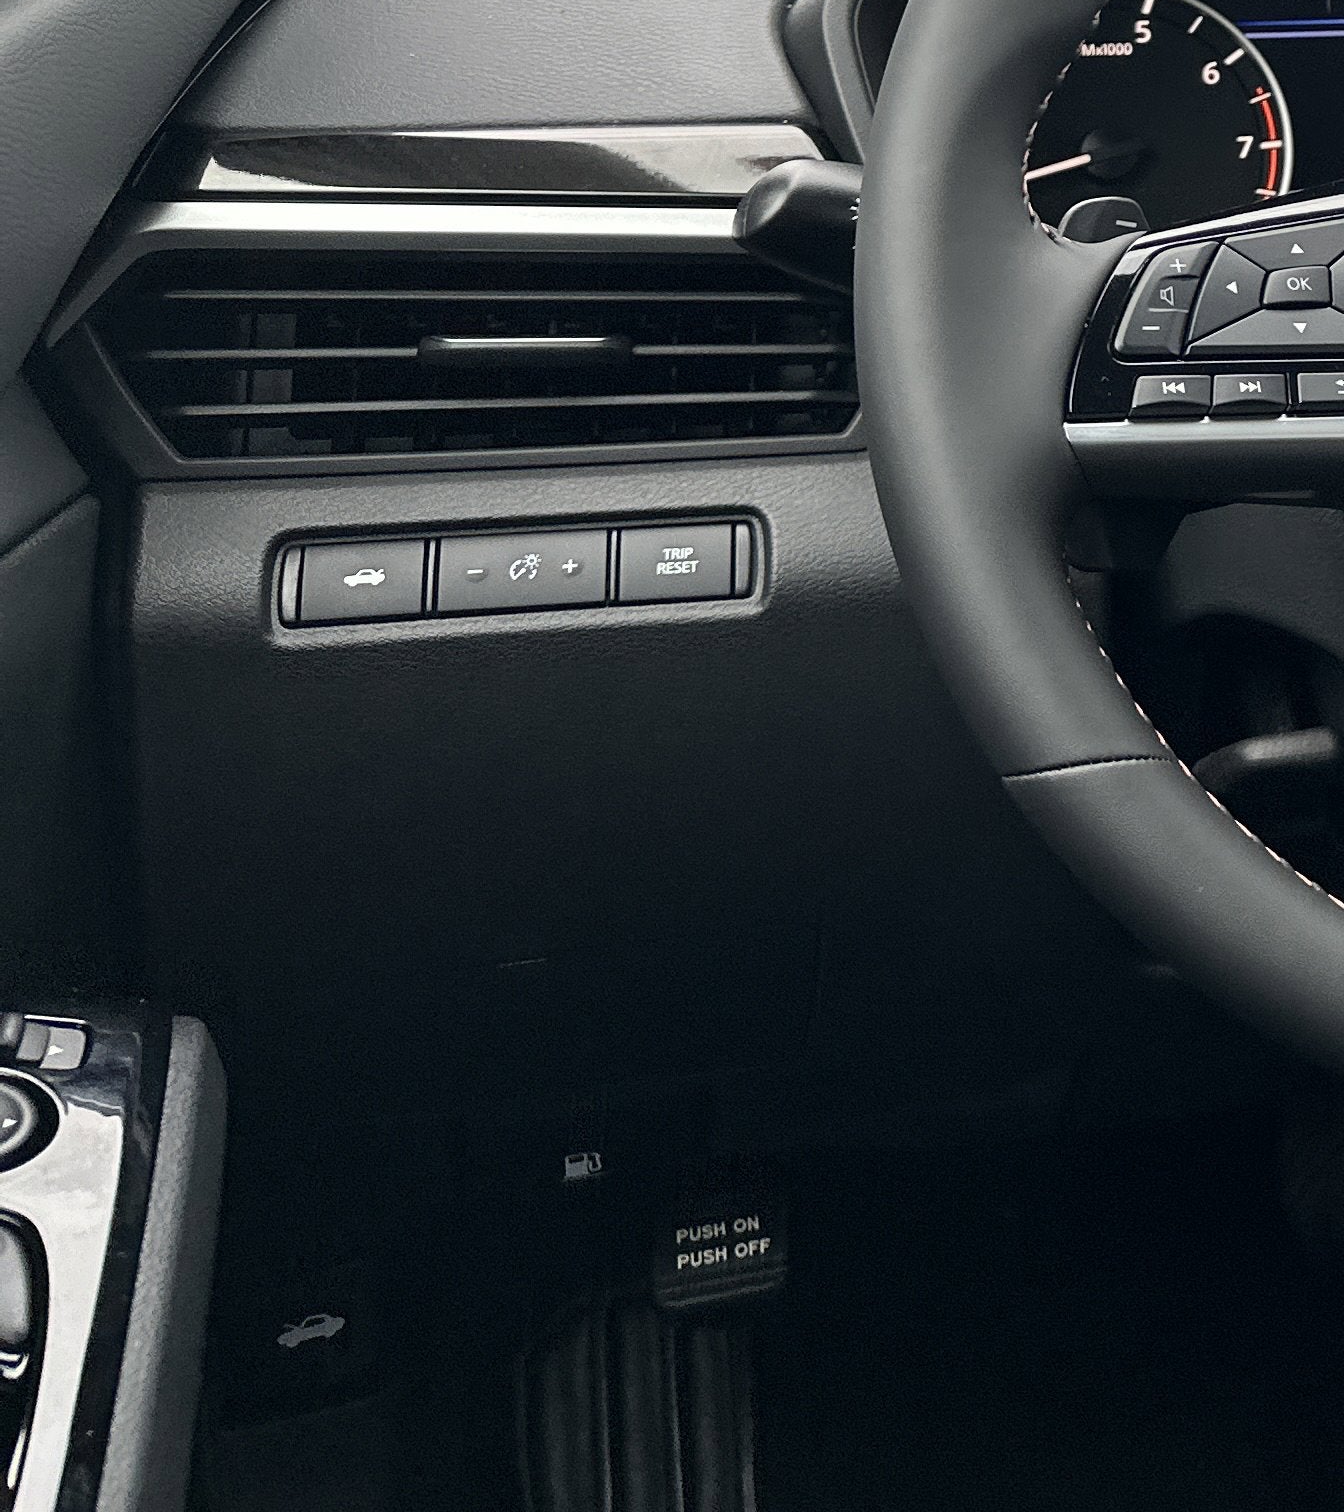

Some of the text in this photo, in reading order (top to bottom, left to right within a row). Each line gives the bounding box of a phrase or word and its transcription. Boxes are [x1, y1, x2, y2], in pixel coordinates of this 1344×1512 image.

[1133, 19, 1152, 44] 5
[1201, 60, 1220, 85] 6
[1235, 135, 1255, 159] 7
[1286, 275, 1313, 292] OK
[662, 546, 695, 562] TRIP
[656, 558, 700, 576] RESET
[675, 1214, 760, 1246] PUSH ON
[676, 1237, 771, 1270] PUSH OFF
